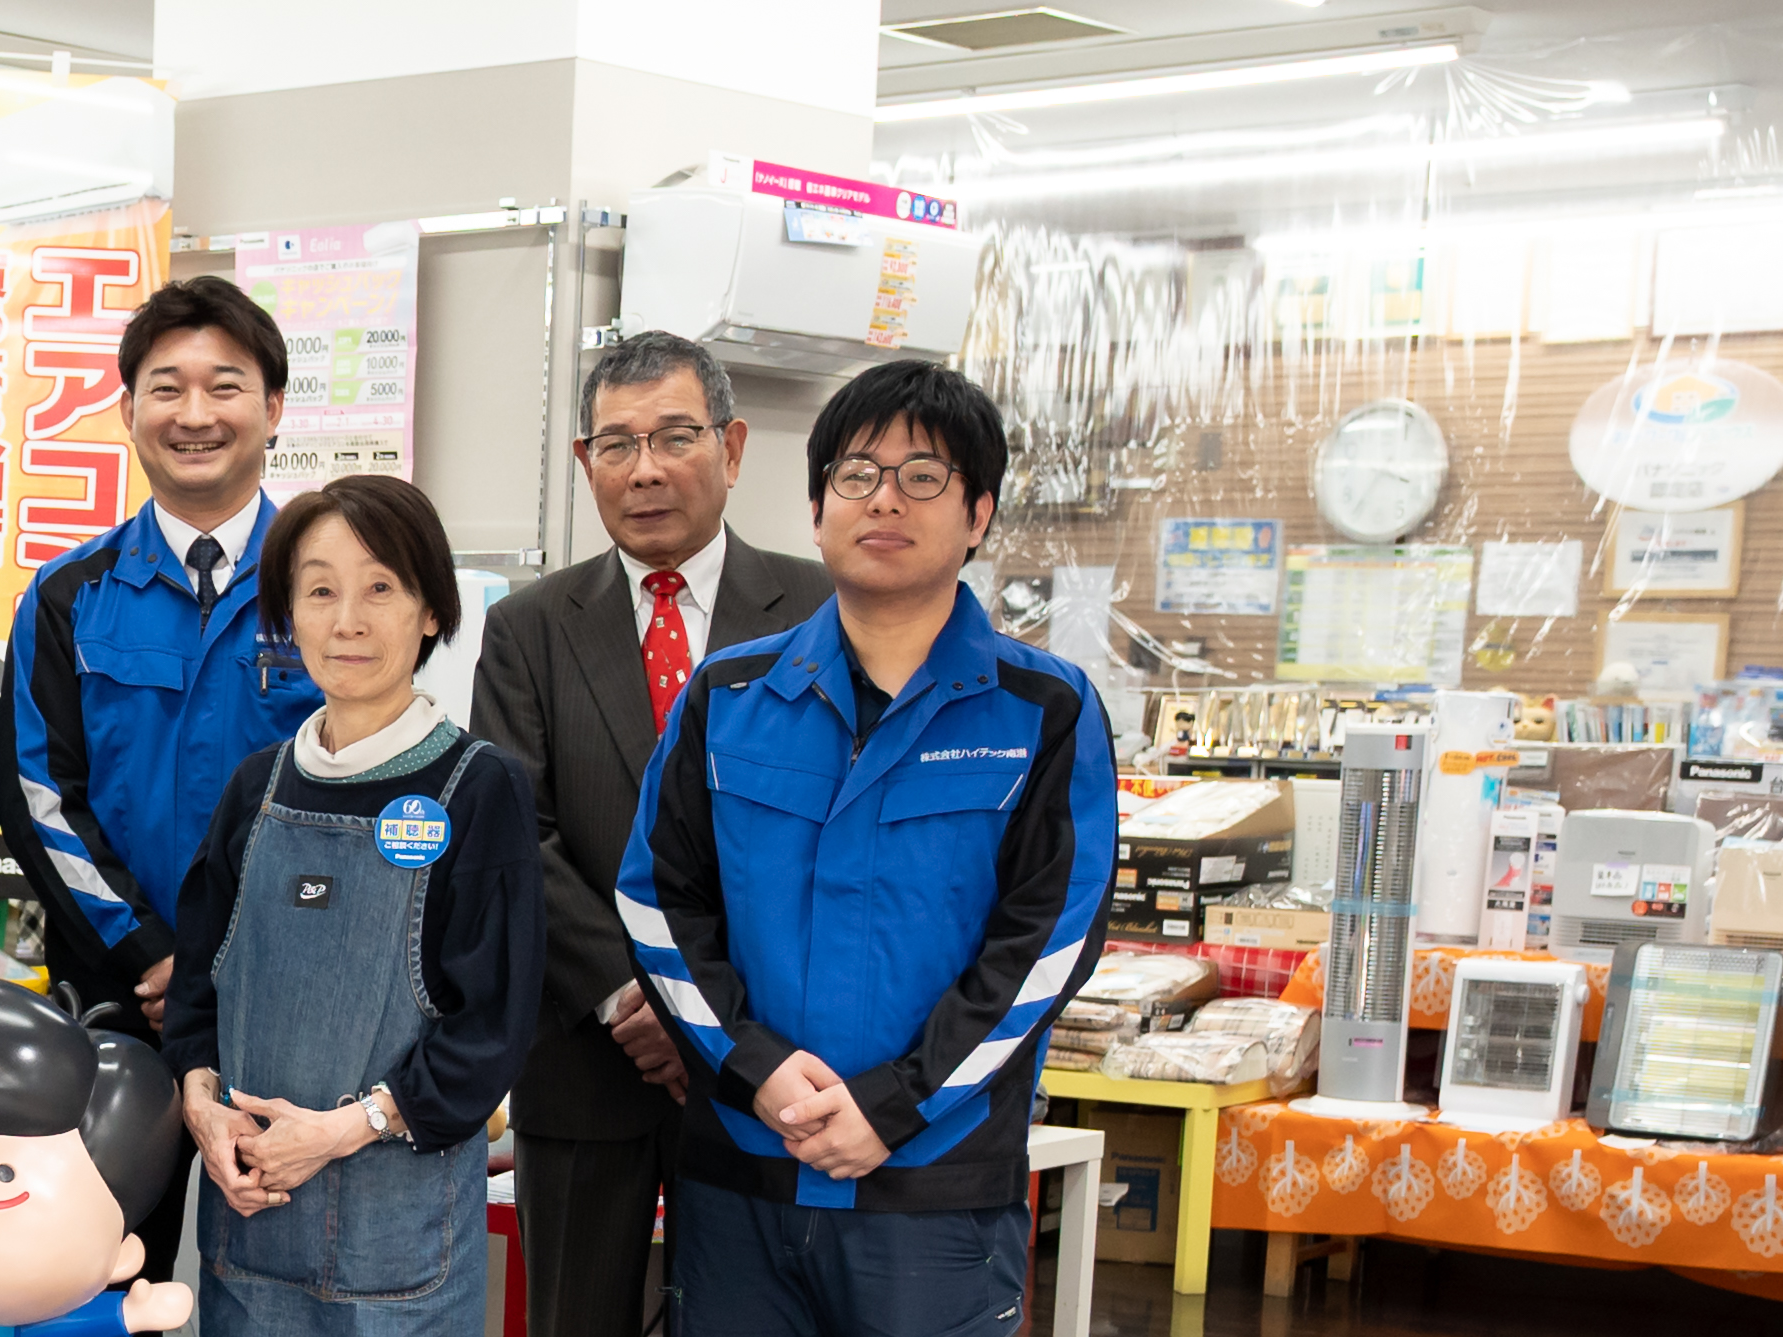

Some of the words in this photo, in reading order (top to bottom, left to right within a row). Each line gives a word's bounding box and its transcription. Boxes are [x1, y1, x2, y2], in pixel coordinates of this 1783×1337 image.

[310, 237, 342, 253] Eolia
[280, 270, 402, 295] キャッシュバック
[920, 747, 1028, 763] 株式会社ハイテック南港
[1689, 764, 1753, 780] Panasonic
[384, 823, 441, 839] 補聴器
